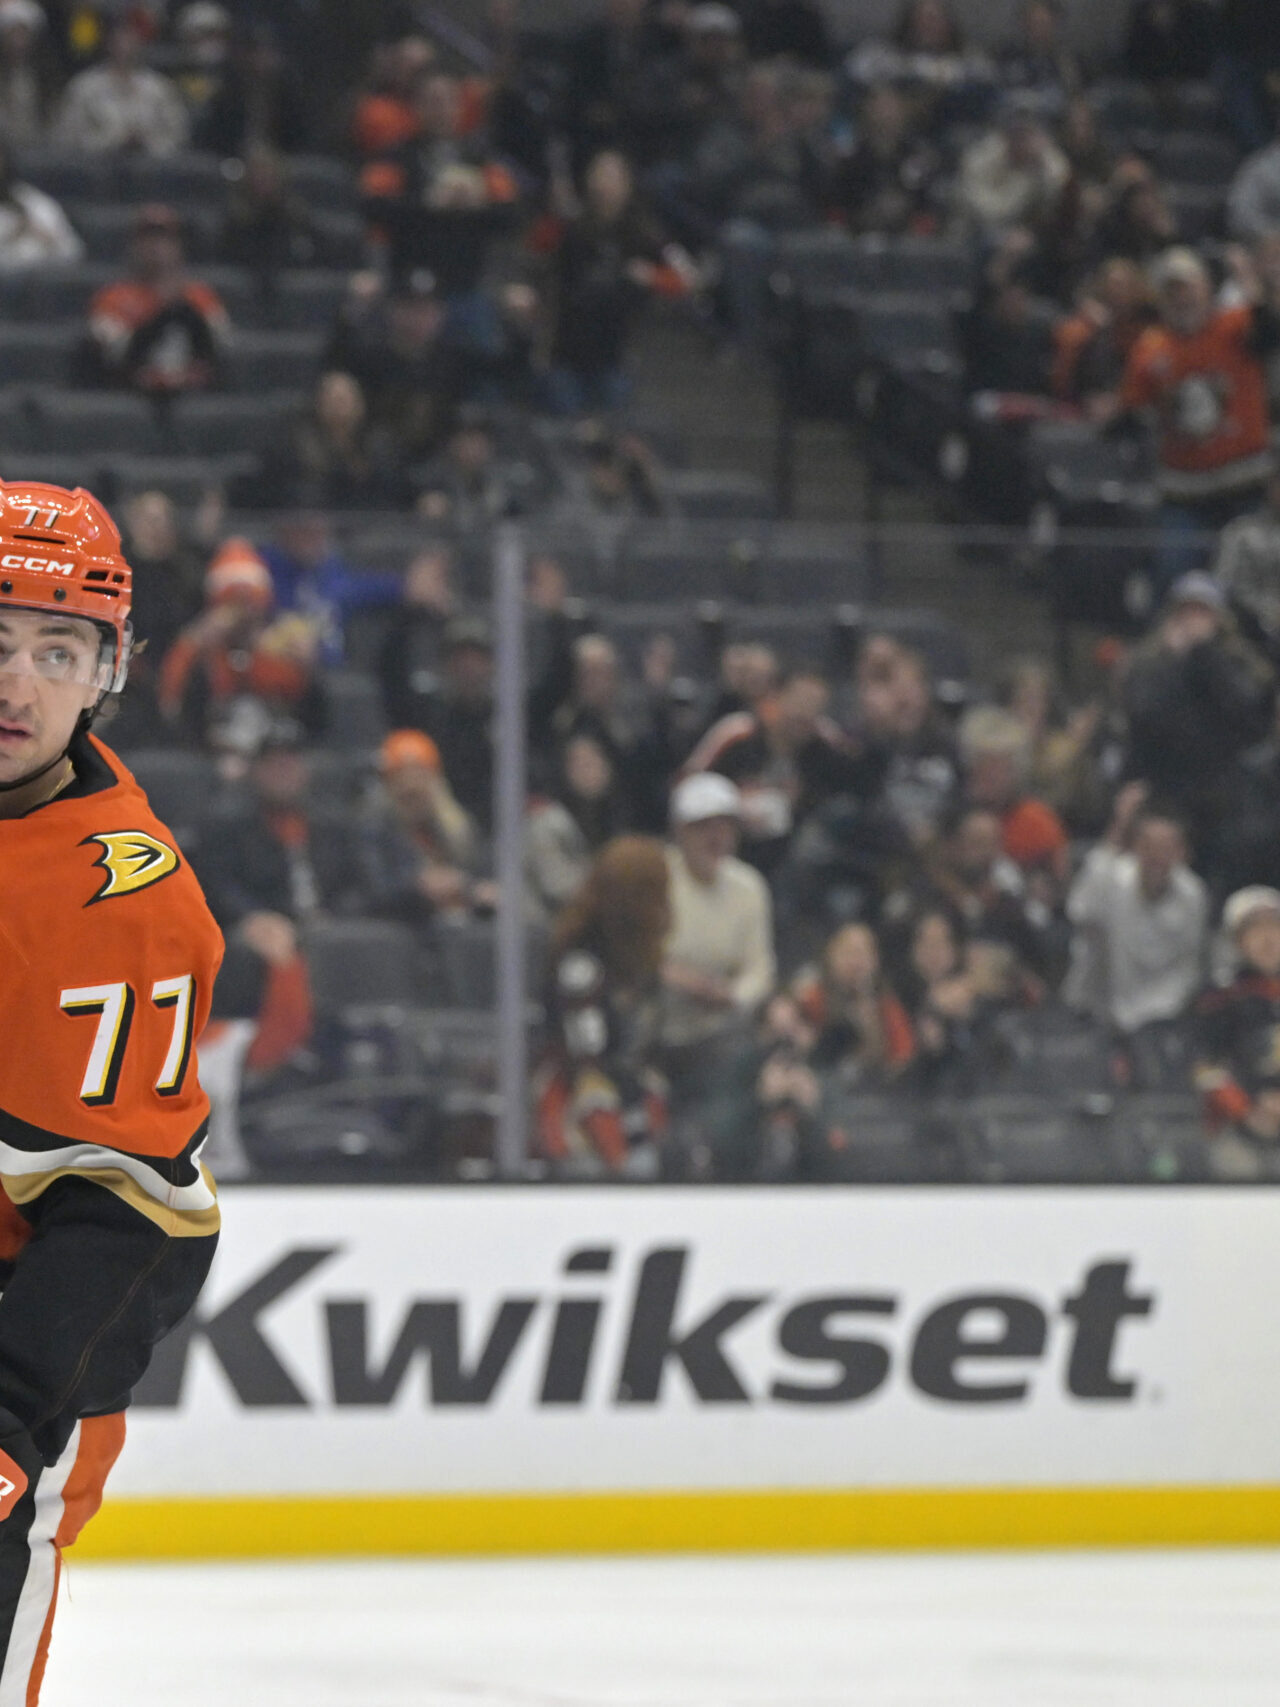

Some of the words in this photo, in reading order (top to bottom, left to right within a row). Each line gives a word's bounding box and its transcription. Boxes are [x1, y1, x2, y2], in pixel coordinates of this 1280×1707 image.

[23, 506, 59, 529] 77
[0, 554, 75, 576] CCM
[59, 973, 197, 1107] 77
[131, 1241, 1154, 1409] Kwikset
